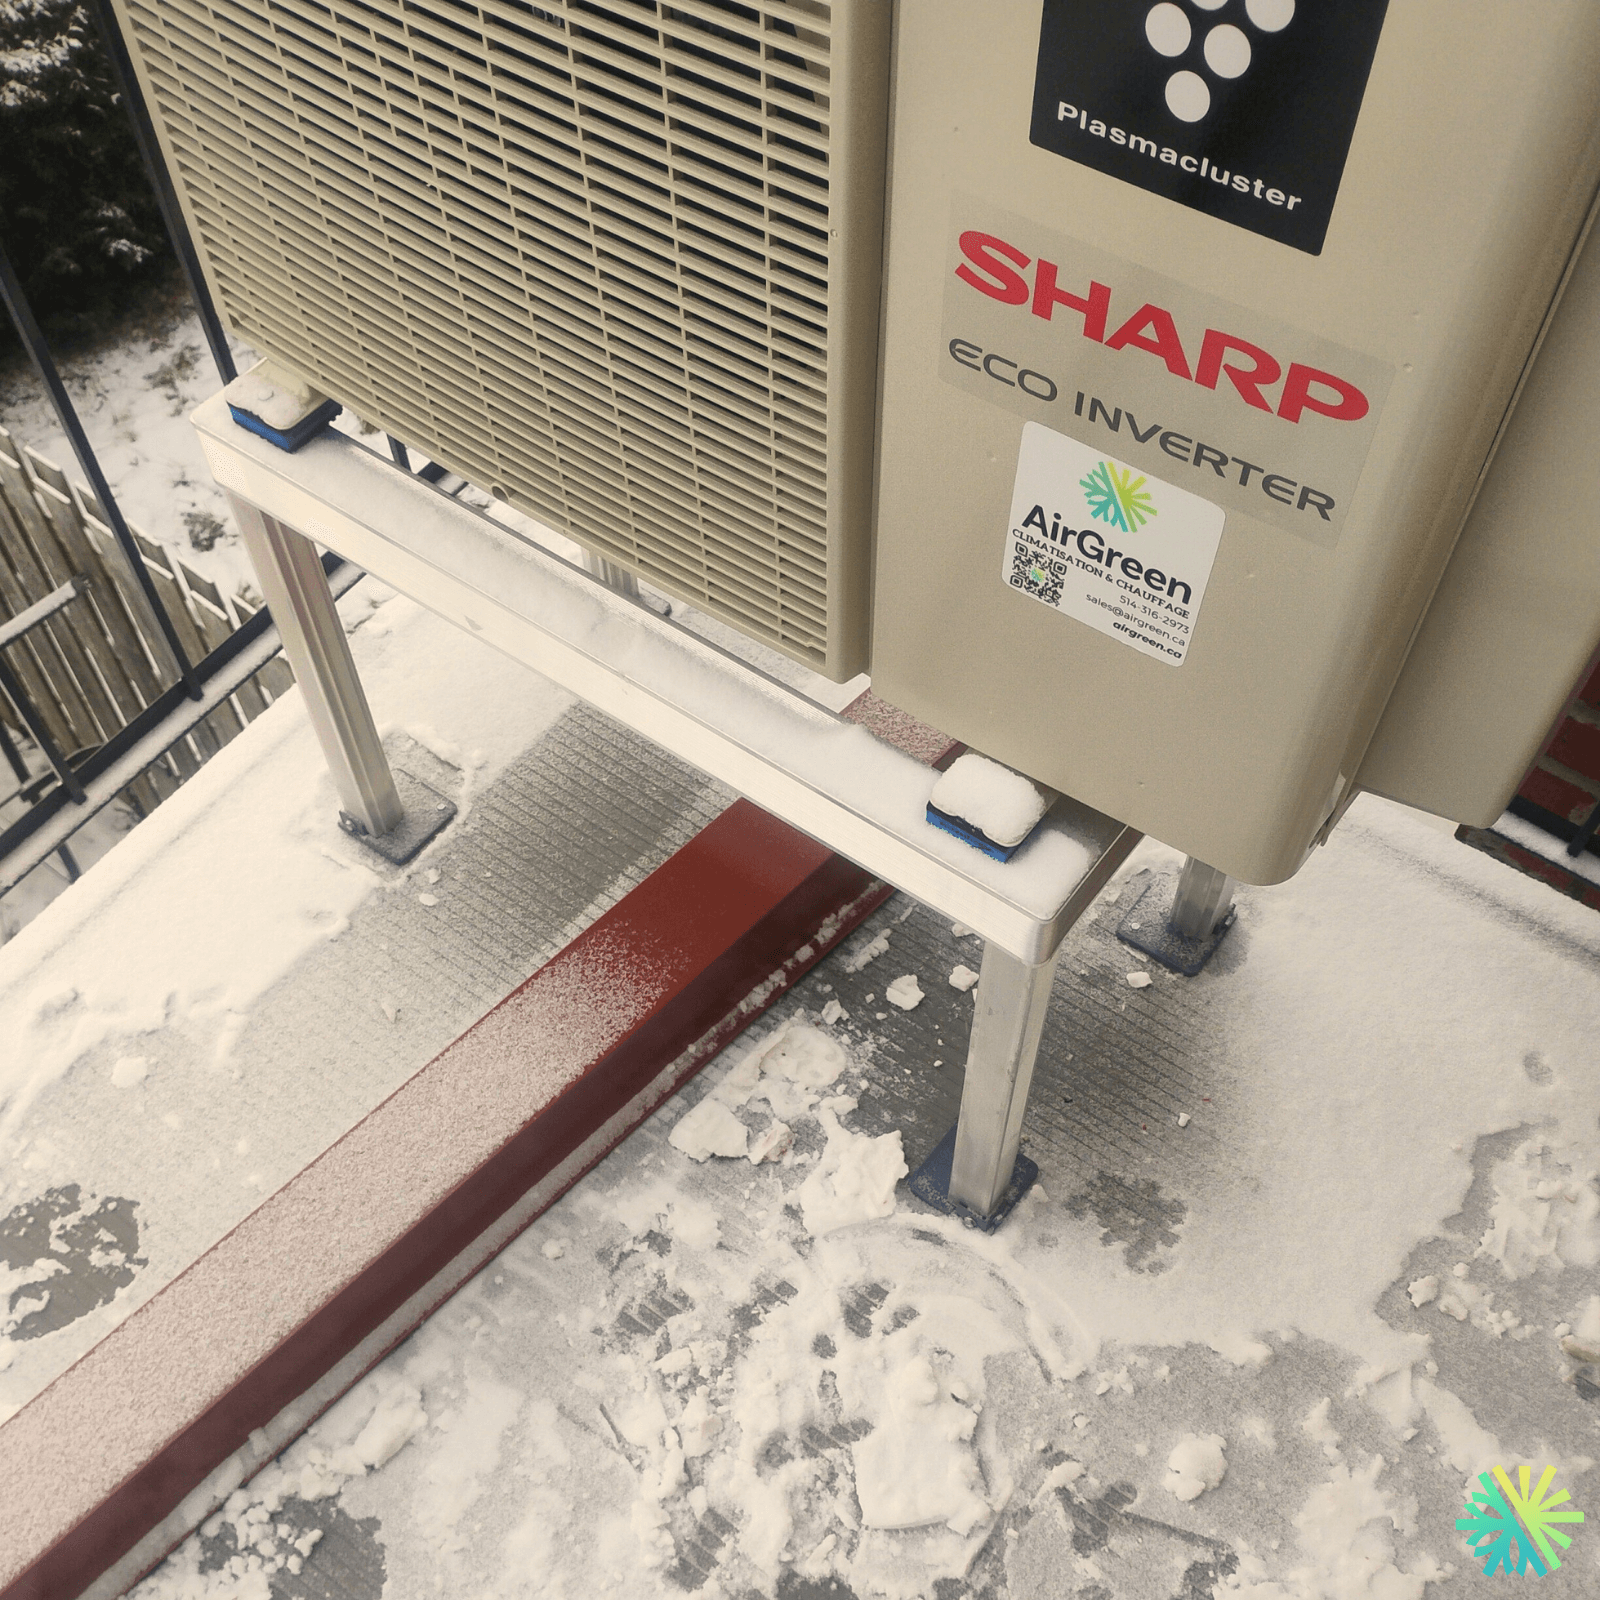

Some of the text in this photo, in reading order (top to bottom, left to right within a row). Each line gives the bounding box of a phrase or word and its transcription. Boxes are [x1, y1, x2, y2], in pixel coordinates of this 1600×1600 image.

[1057, 101, 1302, 211] Plasmacluster
[955, 230, 1369, 424] SHARP
[949, 338, 1335, 522] ECO INVERTER
[1012, 528, 1190, 619] CLIMATISATION & CHAUFFAGE
[1022, 504, 1192, 605] AirGreen
[1086, 593, 1185, 647] sales@airgreen.ca
[1113, 620, 1182, 659] airgreen.ca
[1119, 595, 1189, 635] 514-316-2973
